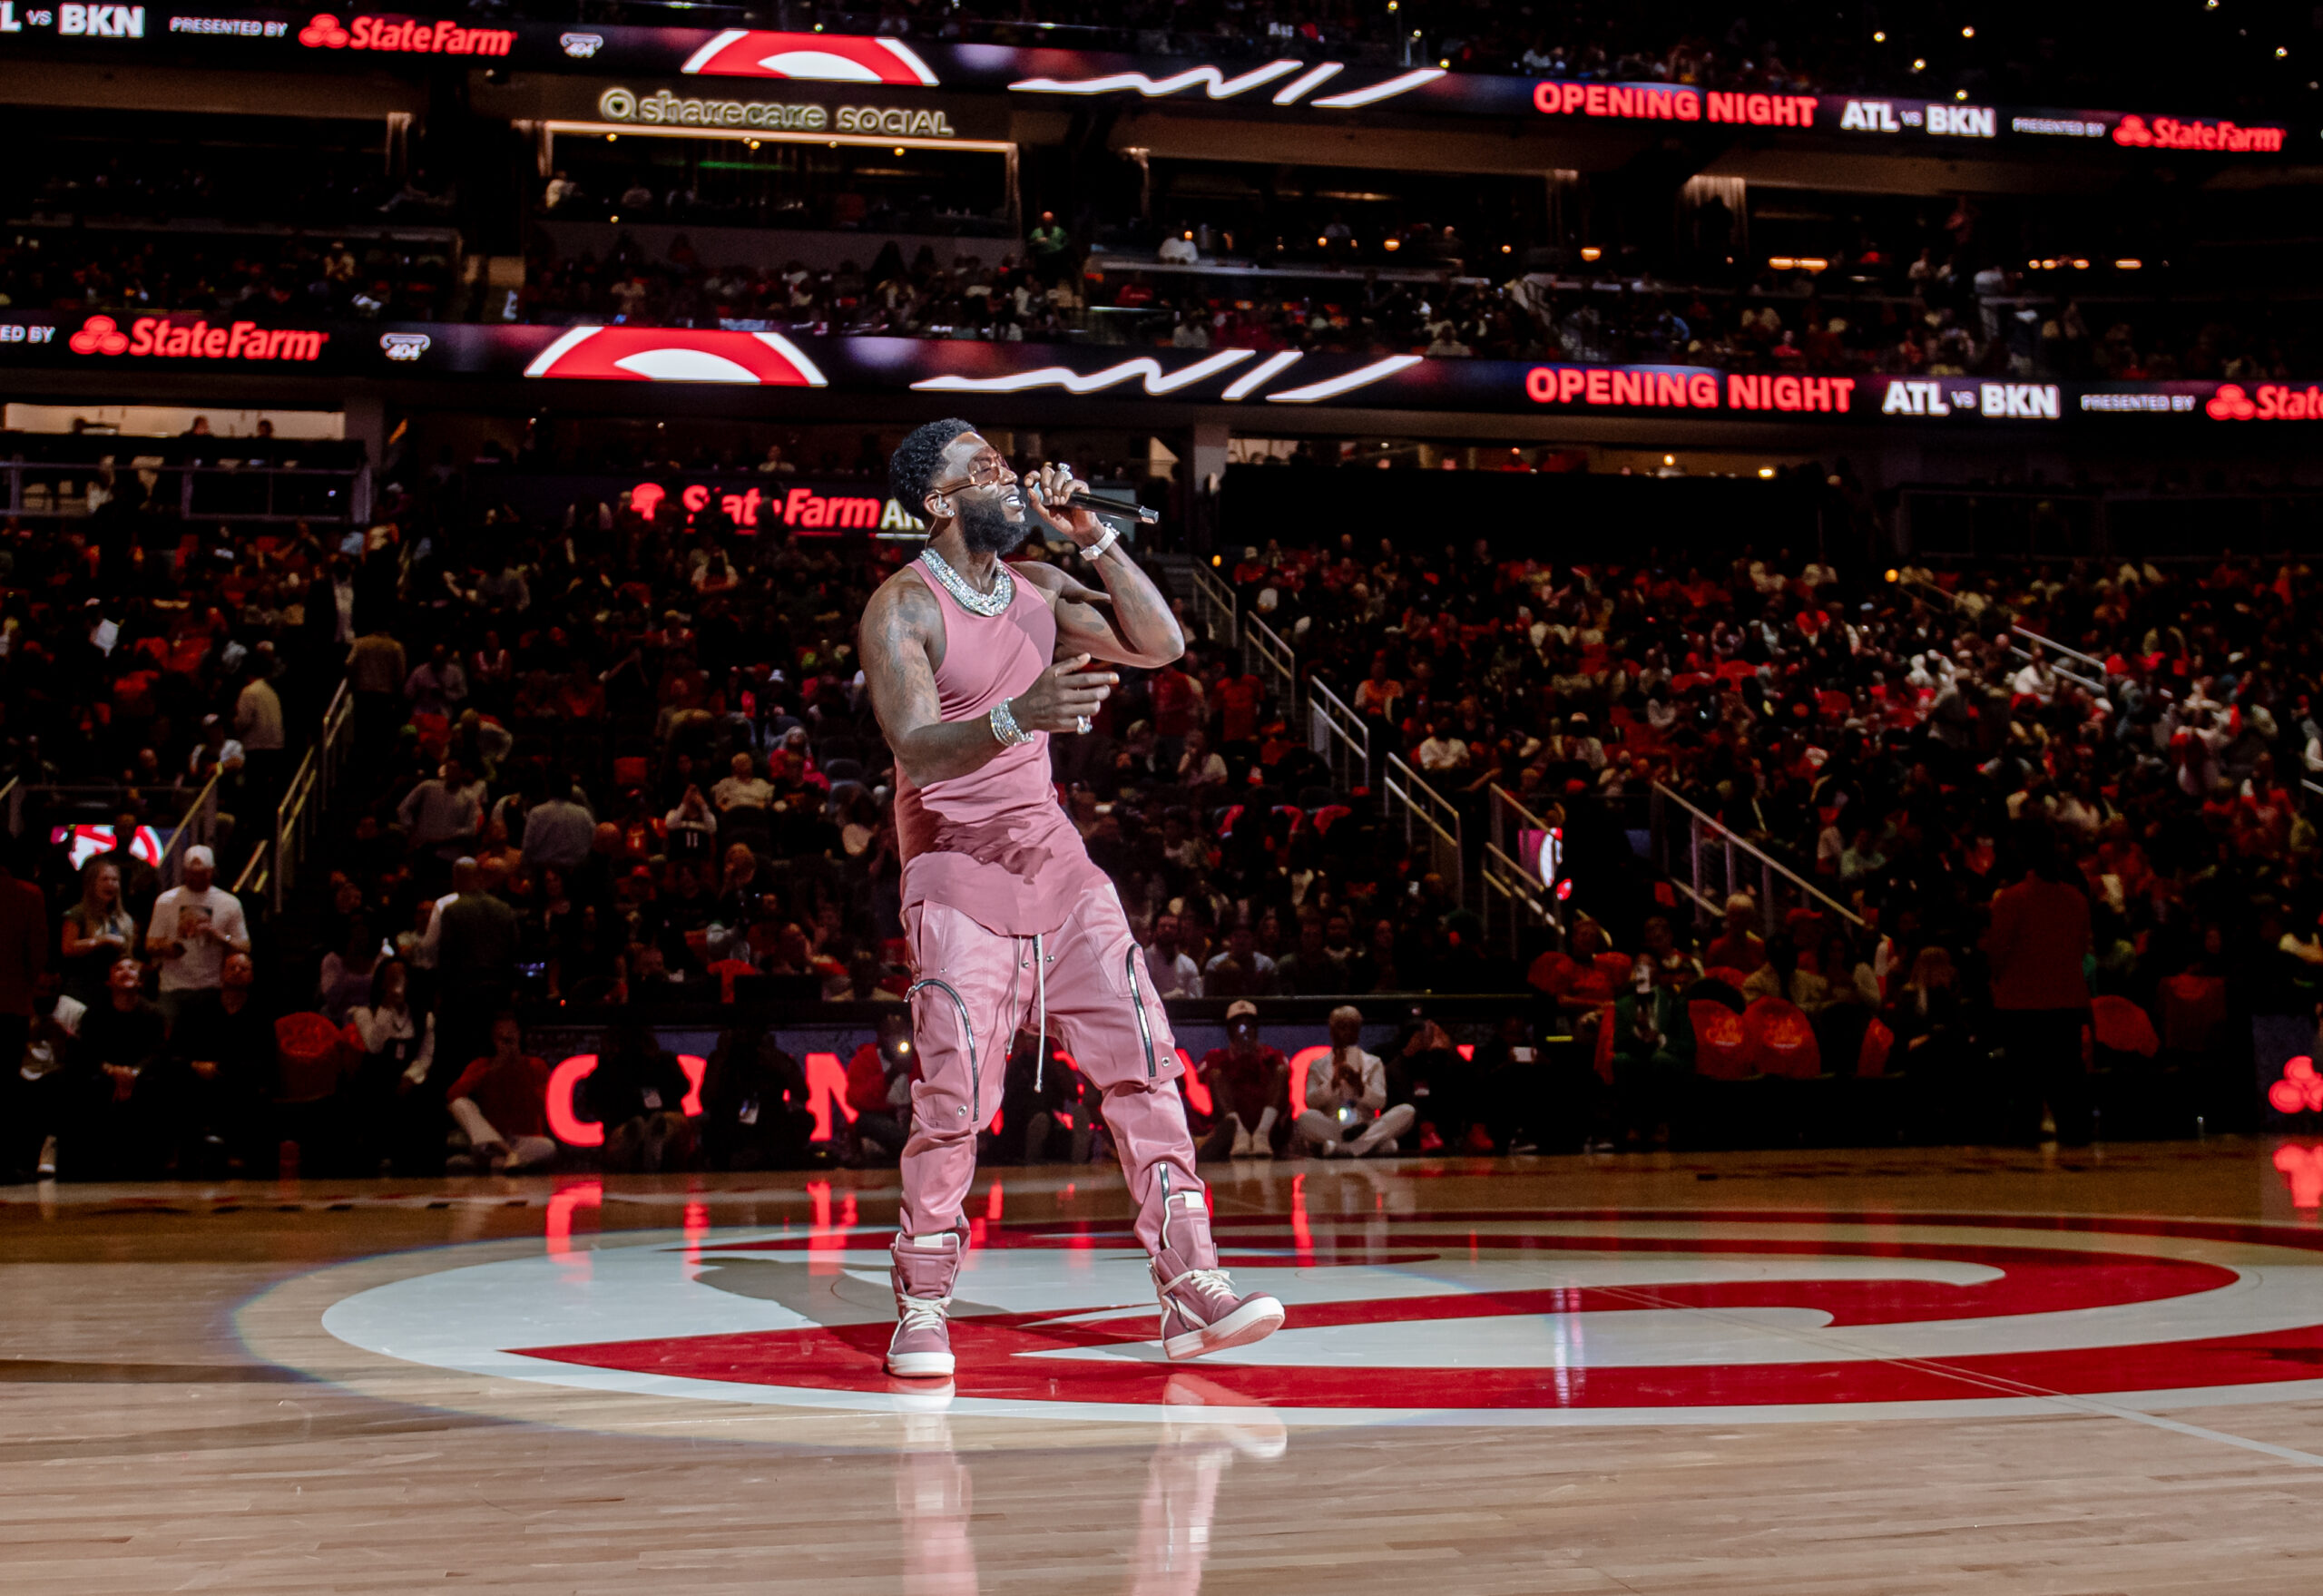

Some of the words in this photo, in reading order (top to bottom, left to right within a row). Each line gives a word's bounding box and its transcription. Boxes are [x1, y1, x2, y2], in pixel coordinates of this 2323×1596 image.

[0, 0, 21, 31] L
[58, 3, 144, 37] BKN
[170, 17, 262, 35] PRESENTED
[264, 21, 287, 36] BY
[350, 16, 512, 55] StateFarm
[639, 91, 827, 130] sharecare
[837, 107, 953, 136] SOCIAL
[1534, 83, 1701, 121] OPENING
[1707, 92, 1818, 127] NIGHT
[1840, 99, 1898, 132] ATL
[1926, 104, 1995, 137] BKN
[2013, 118, 2085, 135] PRESENTED
[2085, 122, 2105, 136] BY
[2151, 117, 2282, 152] StateFarm
[0, 325, 25, 341] ED
[28, 326, 54, 343] BY
[129, 318, 321, 360] StateFarm
[386, 344, 421, 360] 404
[1526, 365, 1719, 407] OPENING
[1728, 375, 1855, 412] NIGHT
[1882, 379, 1949, 416] ATL
[1981, 383, 2060, 418] BKN
[2081, 395, 2170, 411] PRESENTED
[2170, 395, 2195, 411] BY
[2255, 385, 2323, 420] Stat
[682, 485, 880, 528] SatFarm
